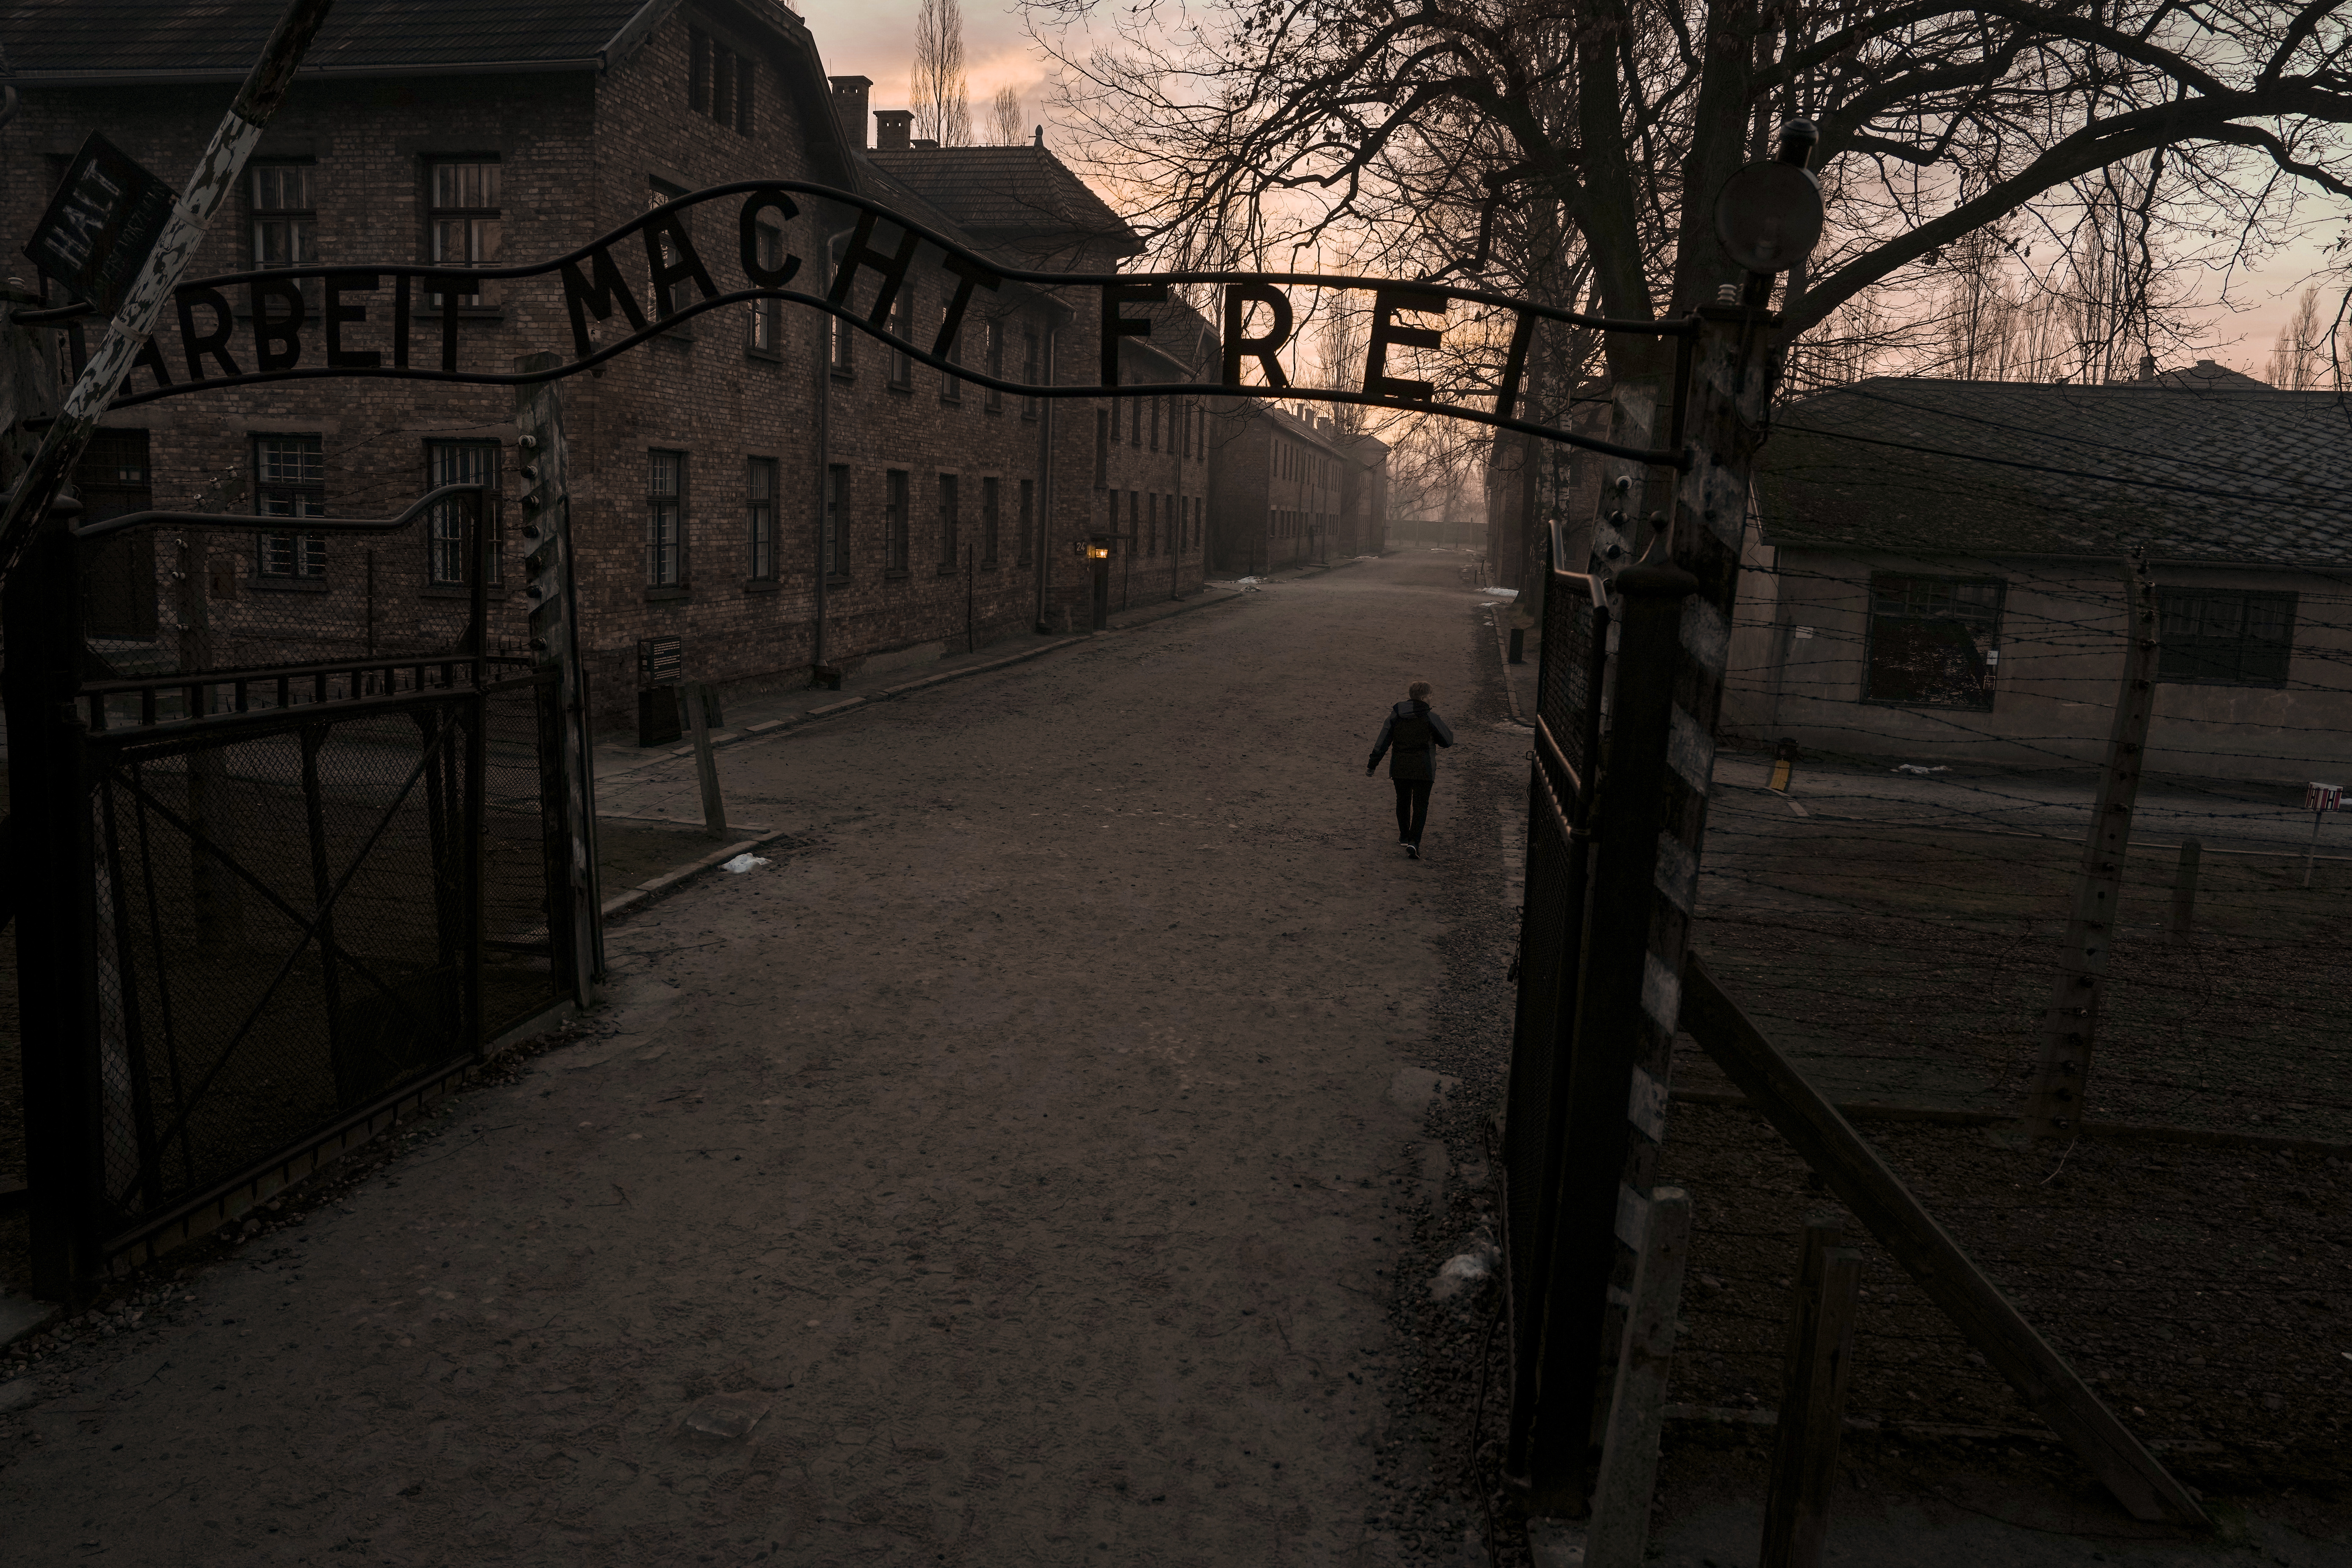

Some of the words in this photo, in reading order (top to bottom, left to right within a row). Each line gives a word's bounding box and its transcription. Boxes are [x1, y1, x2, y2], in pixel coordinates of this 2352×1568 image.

[45, 159, 121, 270] HALT
[559, 187, 1002, 359] MACHT
[1102, 283, 1536, 418] FREI
[1077, 542, 1085, 551] 24
[2310, 788, 2317, 808] H
[2326, 791, 2335, 810] H
